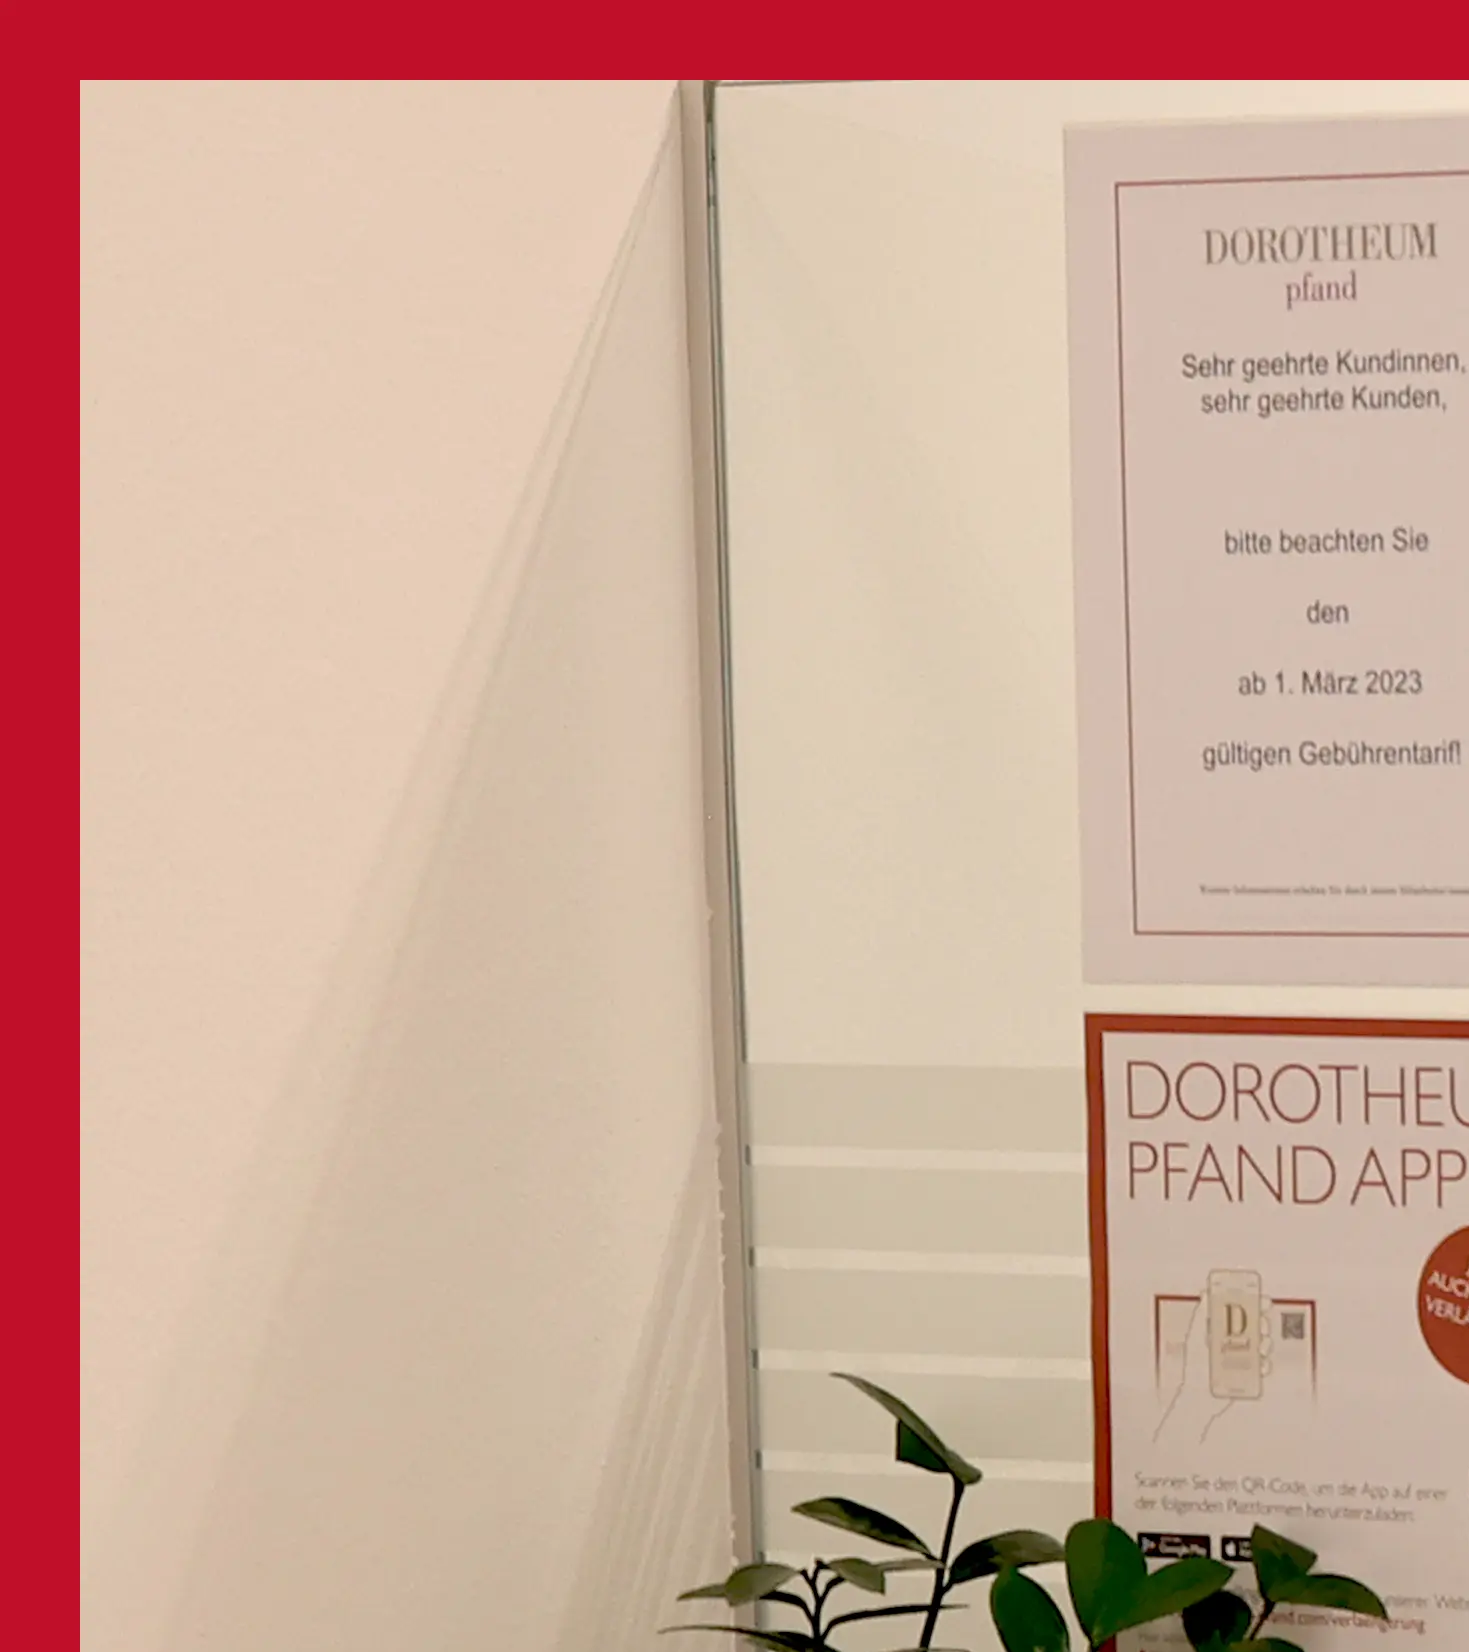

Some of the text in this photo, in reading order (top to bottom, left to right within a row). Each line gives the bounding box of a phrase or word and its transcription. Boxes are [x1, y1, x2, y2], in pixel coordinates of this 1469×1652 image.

[1204, 222, 1438, 266] DOROTHEUM
[1285, 270, 1358, 311] pfand
[1181, 348, 1467, 383] Sehr geehrte Kundinnen,
[1200, 384, 1448, 418] sehr geehrte Kunden,
[1224, 525, 1430, 555] bitte beachten Sie
[1306, 600, 1350, 625] den
[1237, 668, 1424, 695] ab 1. März 2023
[1202, 739, 1462, 771] gültigen Gebührentarif!
[1129, 1141, 1468, 1209] PFAND APP
